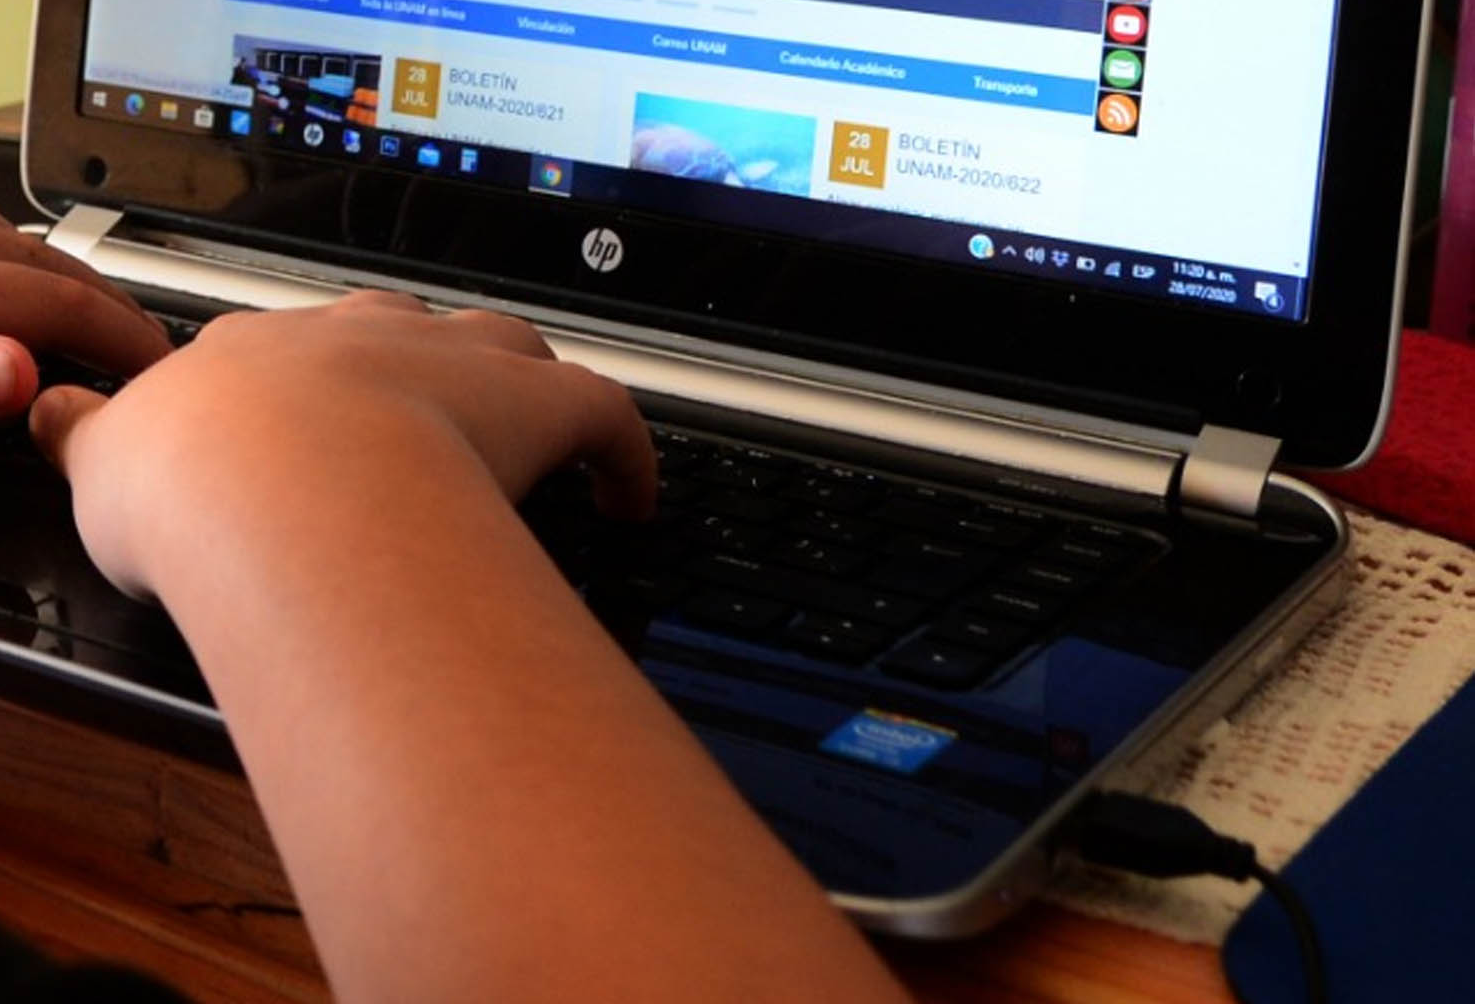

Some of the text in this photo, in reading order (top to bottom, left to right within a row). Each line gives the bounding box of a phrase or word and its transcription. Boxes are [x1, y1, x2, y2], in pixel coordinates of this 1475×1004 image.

[408, 66, 427, 84] 28
[449, 68, 518, 92] BOLETÍN
[400, 89, 430, 107] JUL
[848, 130, 871, 149] 28
[898, 133, 981, 160] BOLETÍN
[839, 156, 874, 176] JUL
[586, 228, 619, 272] hp
